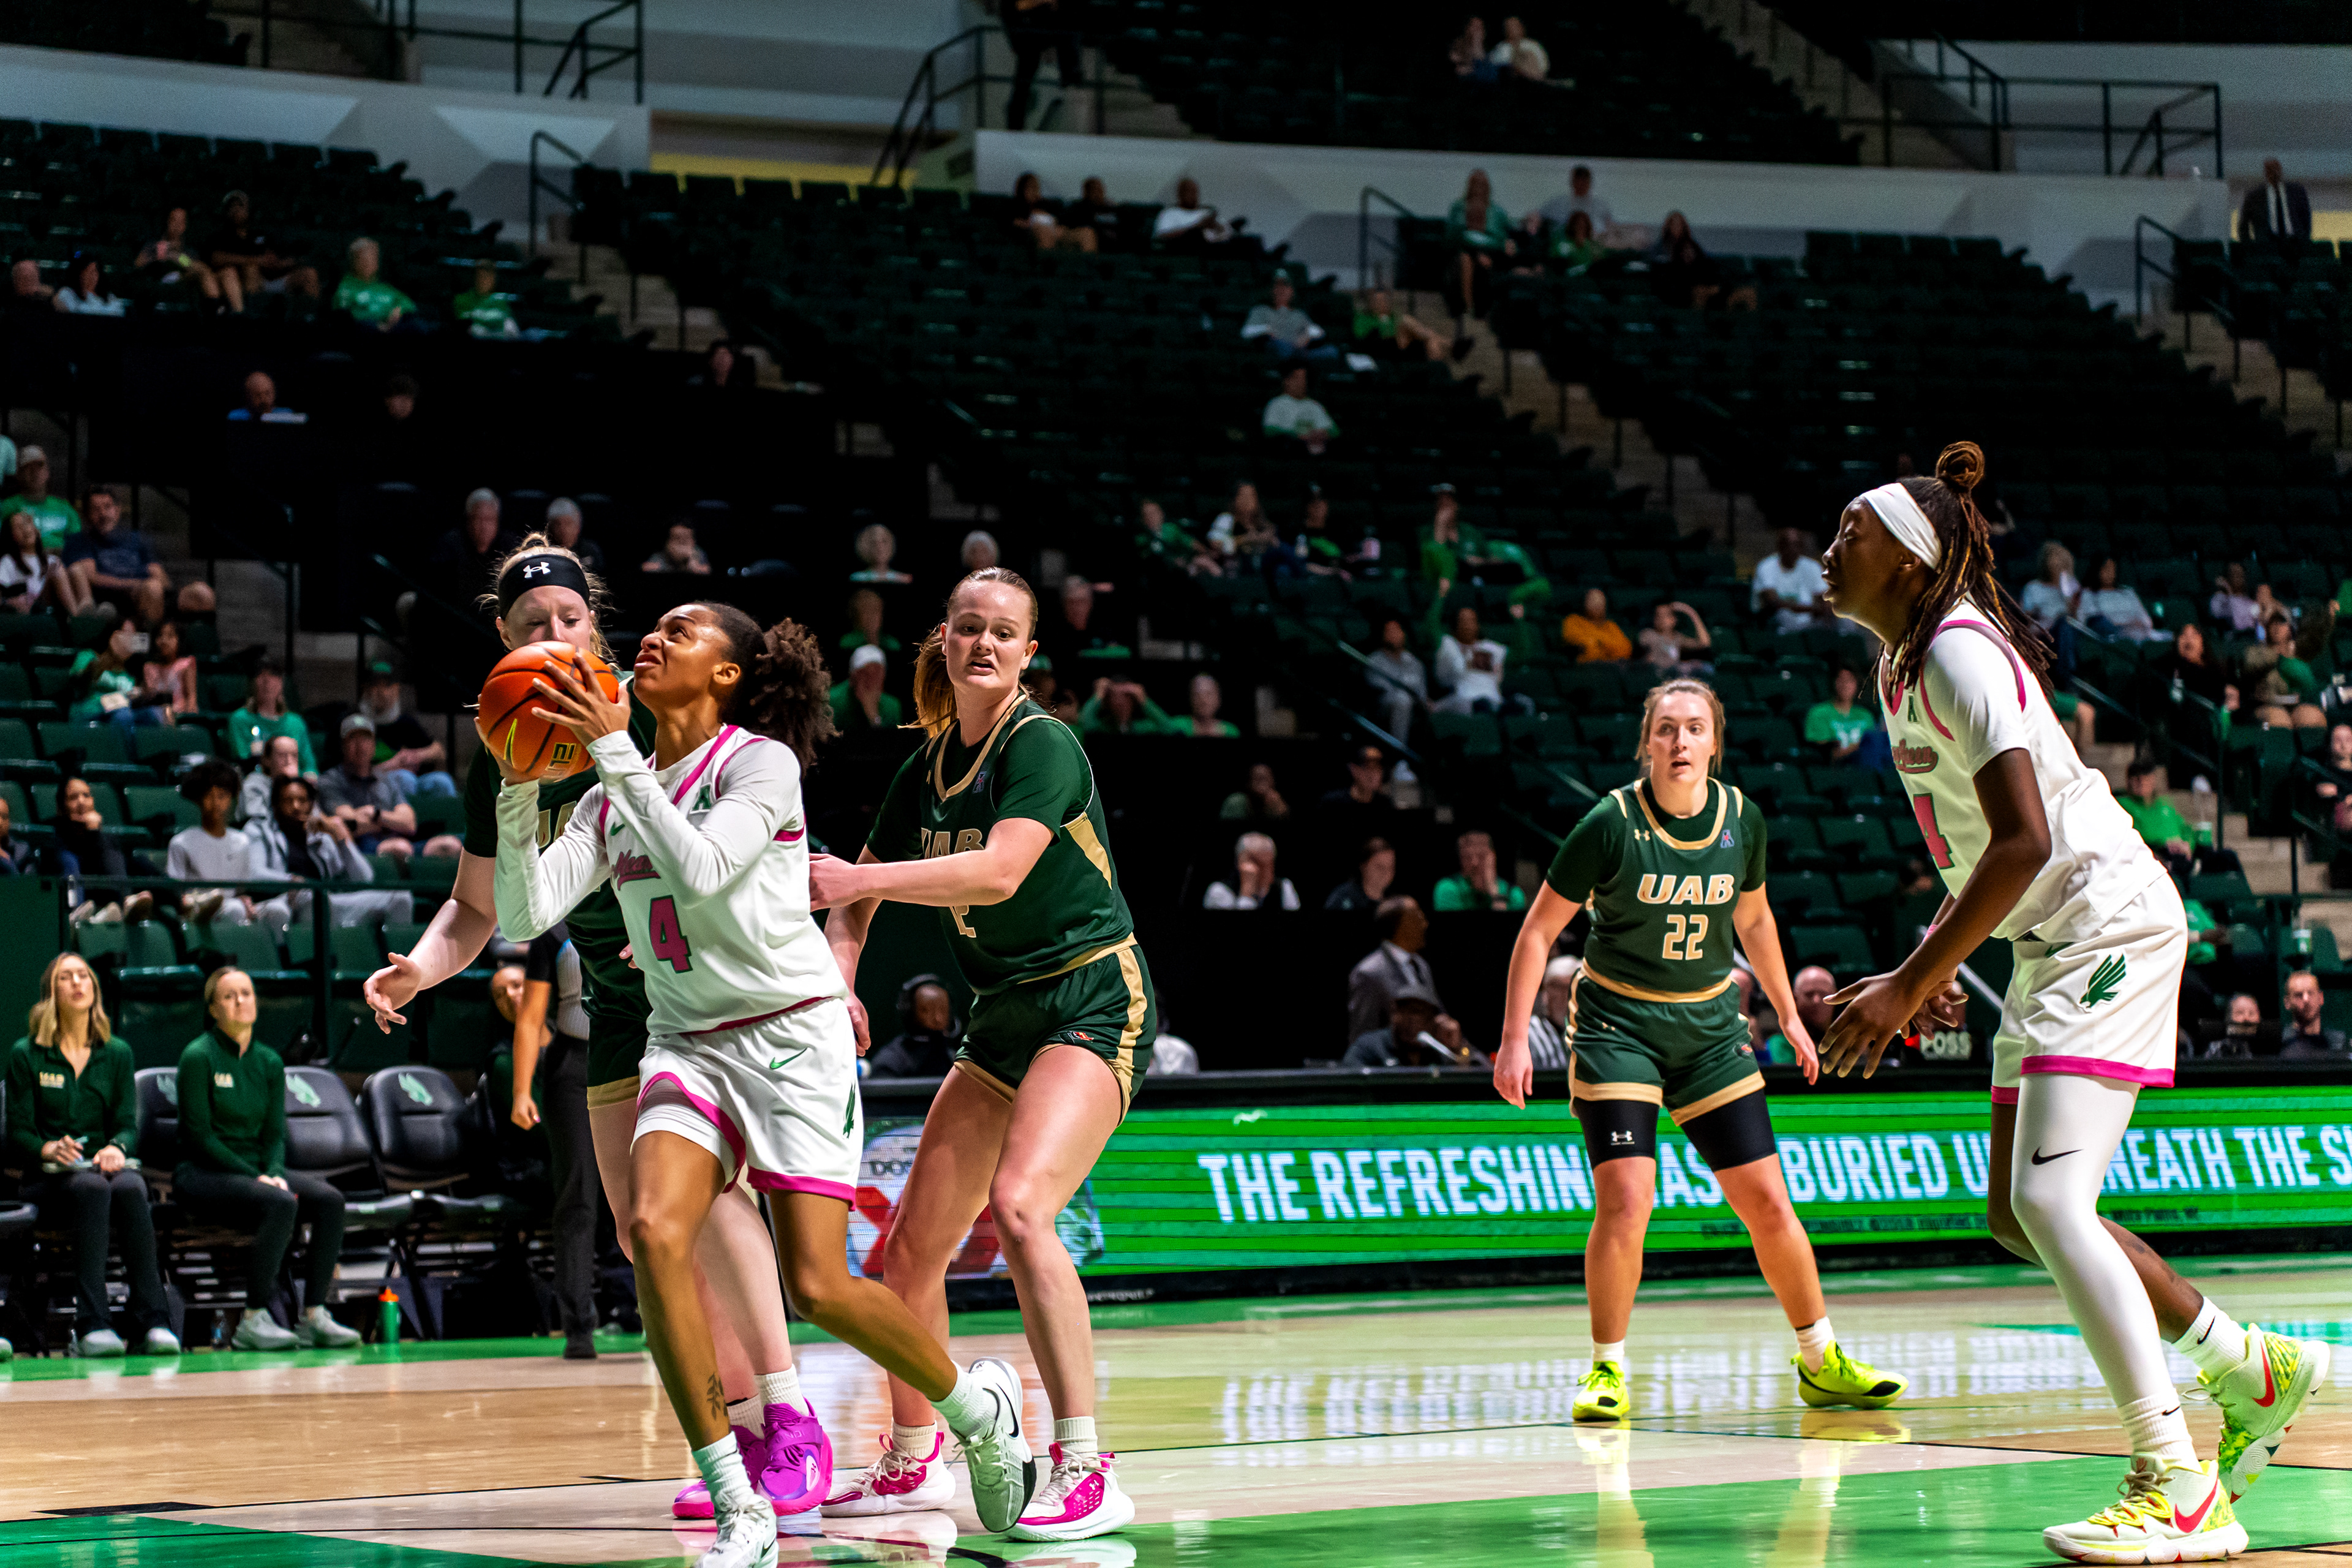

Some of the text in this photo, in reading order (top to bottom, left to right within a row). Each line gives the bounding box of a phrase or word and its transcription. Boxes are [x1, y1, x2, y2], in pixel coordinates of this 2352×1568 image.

[1637, 873, 1735, 905] UAB
[649, 895, 693, 974] 4
[1662, 914, 1709, 960] 22
[1198, 1152, 1309, 1221] THE
[1778, 1134, 1948, 1202] BURIED
[2233, 1126, 2320, 1188] THE
